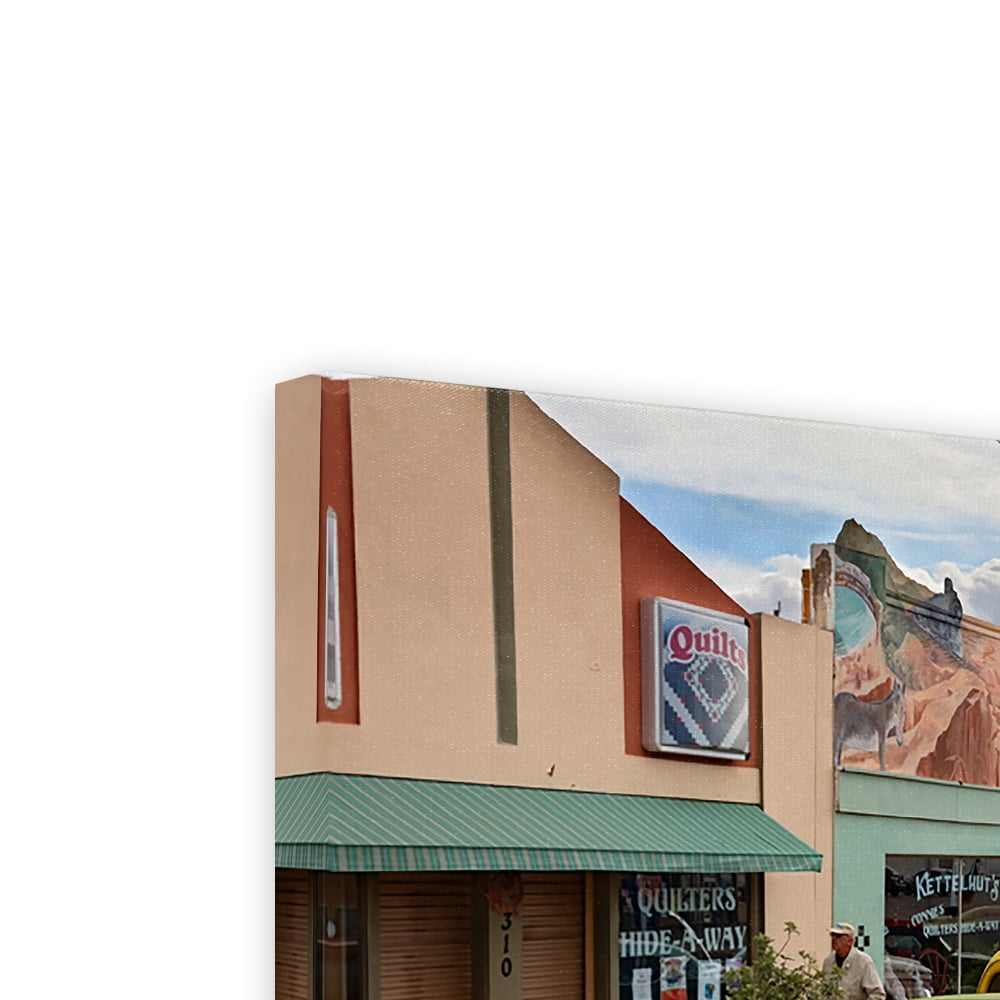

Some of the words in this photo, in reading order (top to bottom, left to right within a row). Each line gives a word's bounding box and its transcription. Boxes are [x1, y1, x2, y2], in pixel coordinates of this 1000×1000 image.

[670, 625, 745, 671] Quilts
[638, 887, 736, 917] QUILTERS
[915, 872, 999, 901] KETTELHUT'S
[501, 912, 512, 977] 310
[619, 926, 747, 958] HIDE-A-WAY
